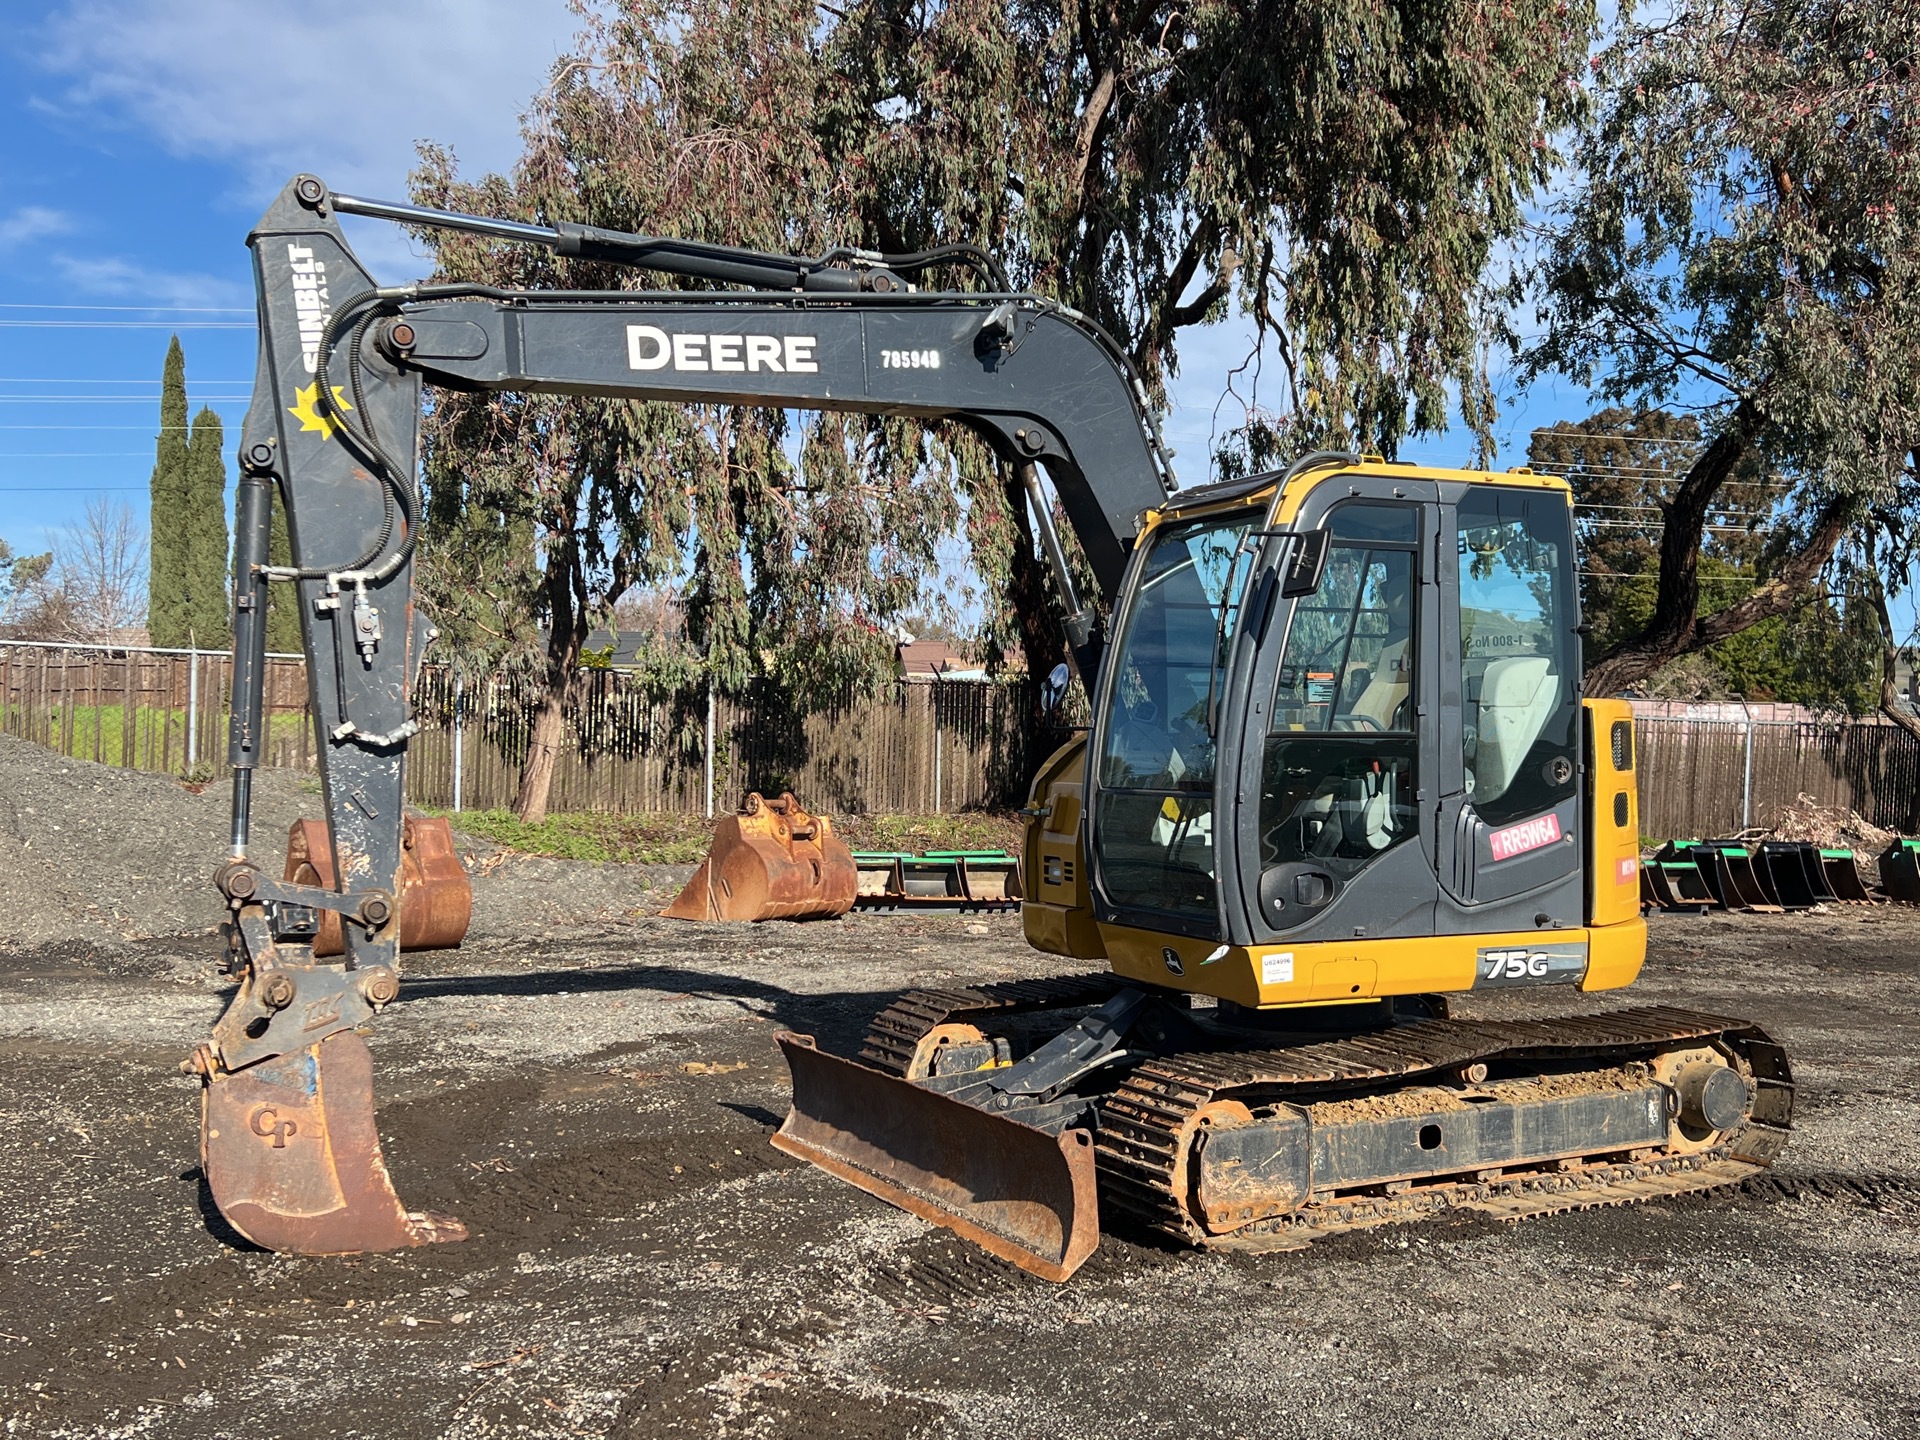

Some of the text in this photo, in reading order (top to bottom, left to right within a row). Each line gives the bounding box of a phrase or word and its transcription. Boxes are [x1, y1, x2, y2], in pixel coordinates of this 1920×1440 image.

[288, 244, 323, 373] SUNBELT
[626, 325, 818, 372] DEERE
[881, 350, 940, 369] 785948
[1501, 817, 1555, 855] RR5W64
[1484, 949, 1548, 980] 75G
